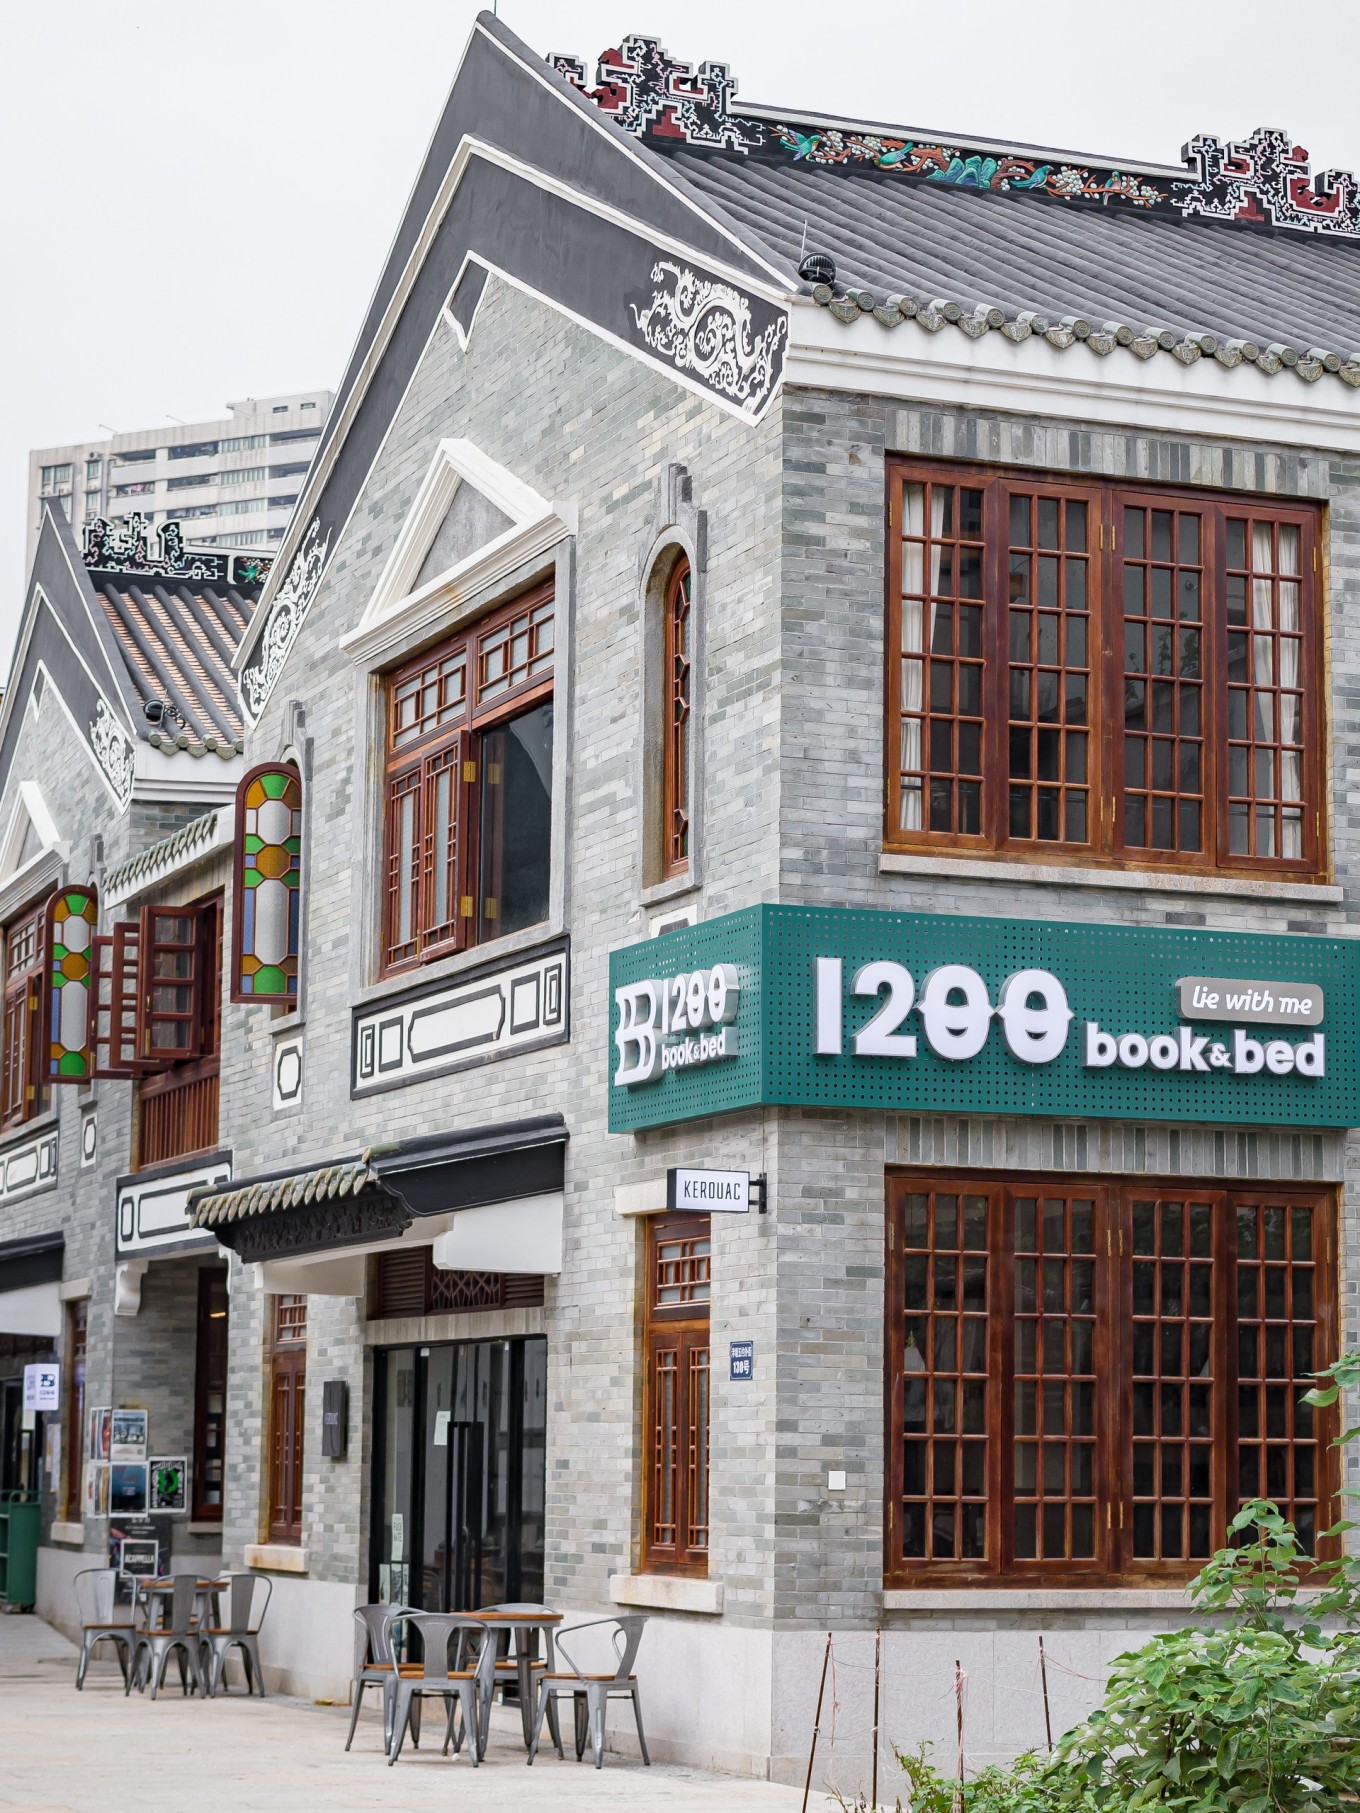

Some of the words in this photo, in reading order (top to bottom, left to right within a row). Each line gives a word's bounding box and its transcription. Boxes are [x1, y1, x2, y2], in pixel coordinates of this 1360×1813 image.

[614, 979, 660, 1087] B
[662, 963, 732, 1036] 1200
[813, 956, 1074, 1064] 1200
[1192, 985, 1220, 1010] lie
[1226, 988, 1274, 1013] with
[1279, 996, 1313, 1015] me
[684, 1180, 741, 1201] KEROUAC
